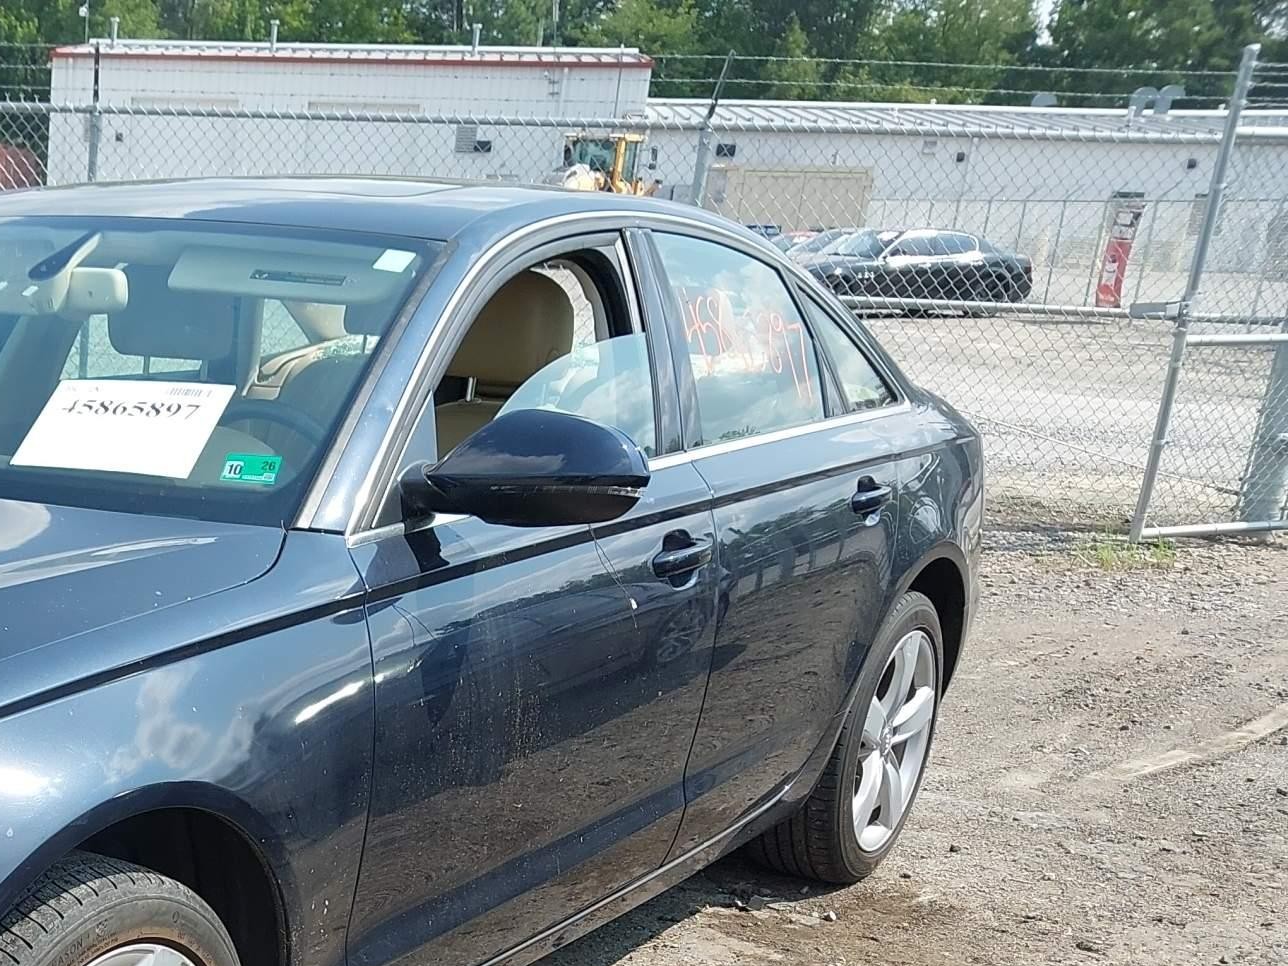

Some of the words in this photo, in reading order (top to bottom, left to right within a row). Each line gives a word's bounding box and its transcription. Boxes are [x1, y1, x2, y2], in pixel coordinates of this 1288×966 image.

[61, 399, 200, 420] 45865897
[227, 463, 242, 475] 10
[261, 460, 276, 471] 26
